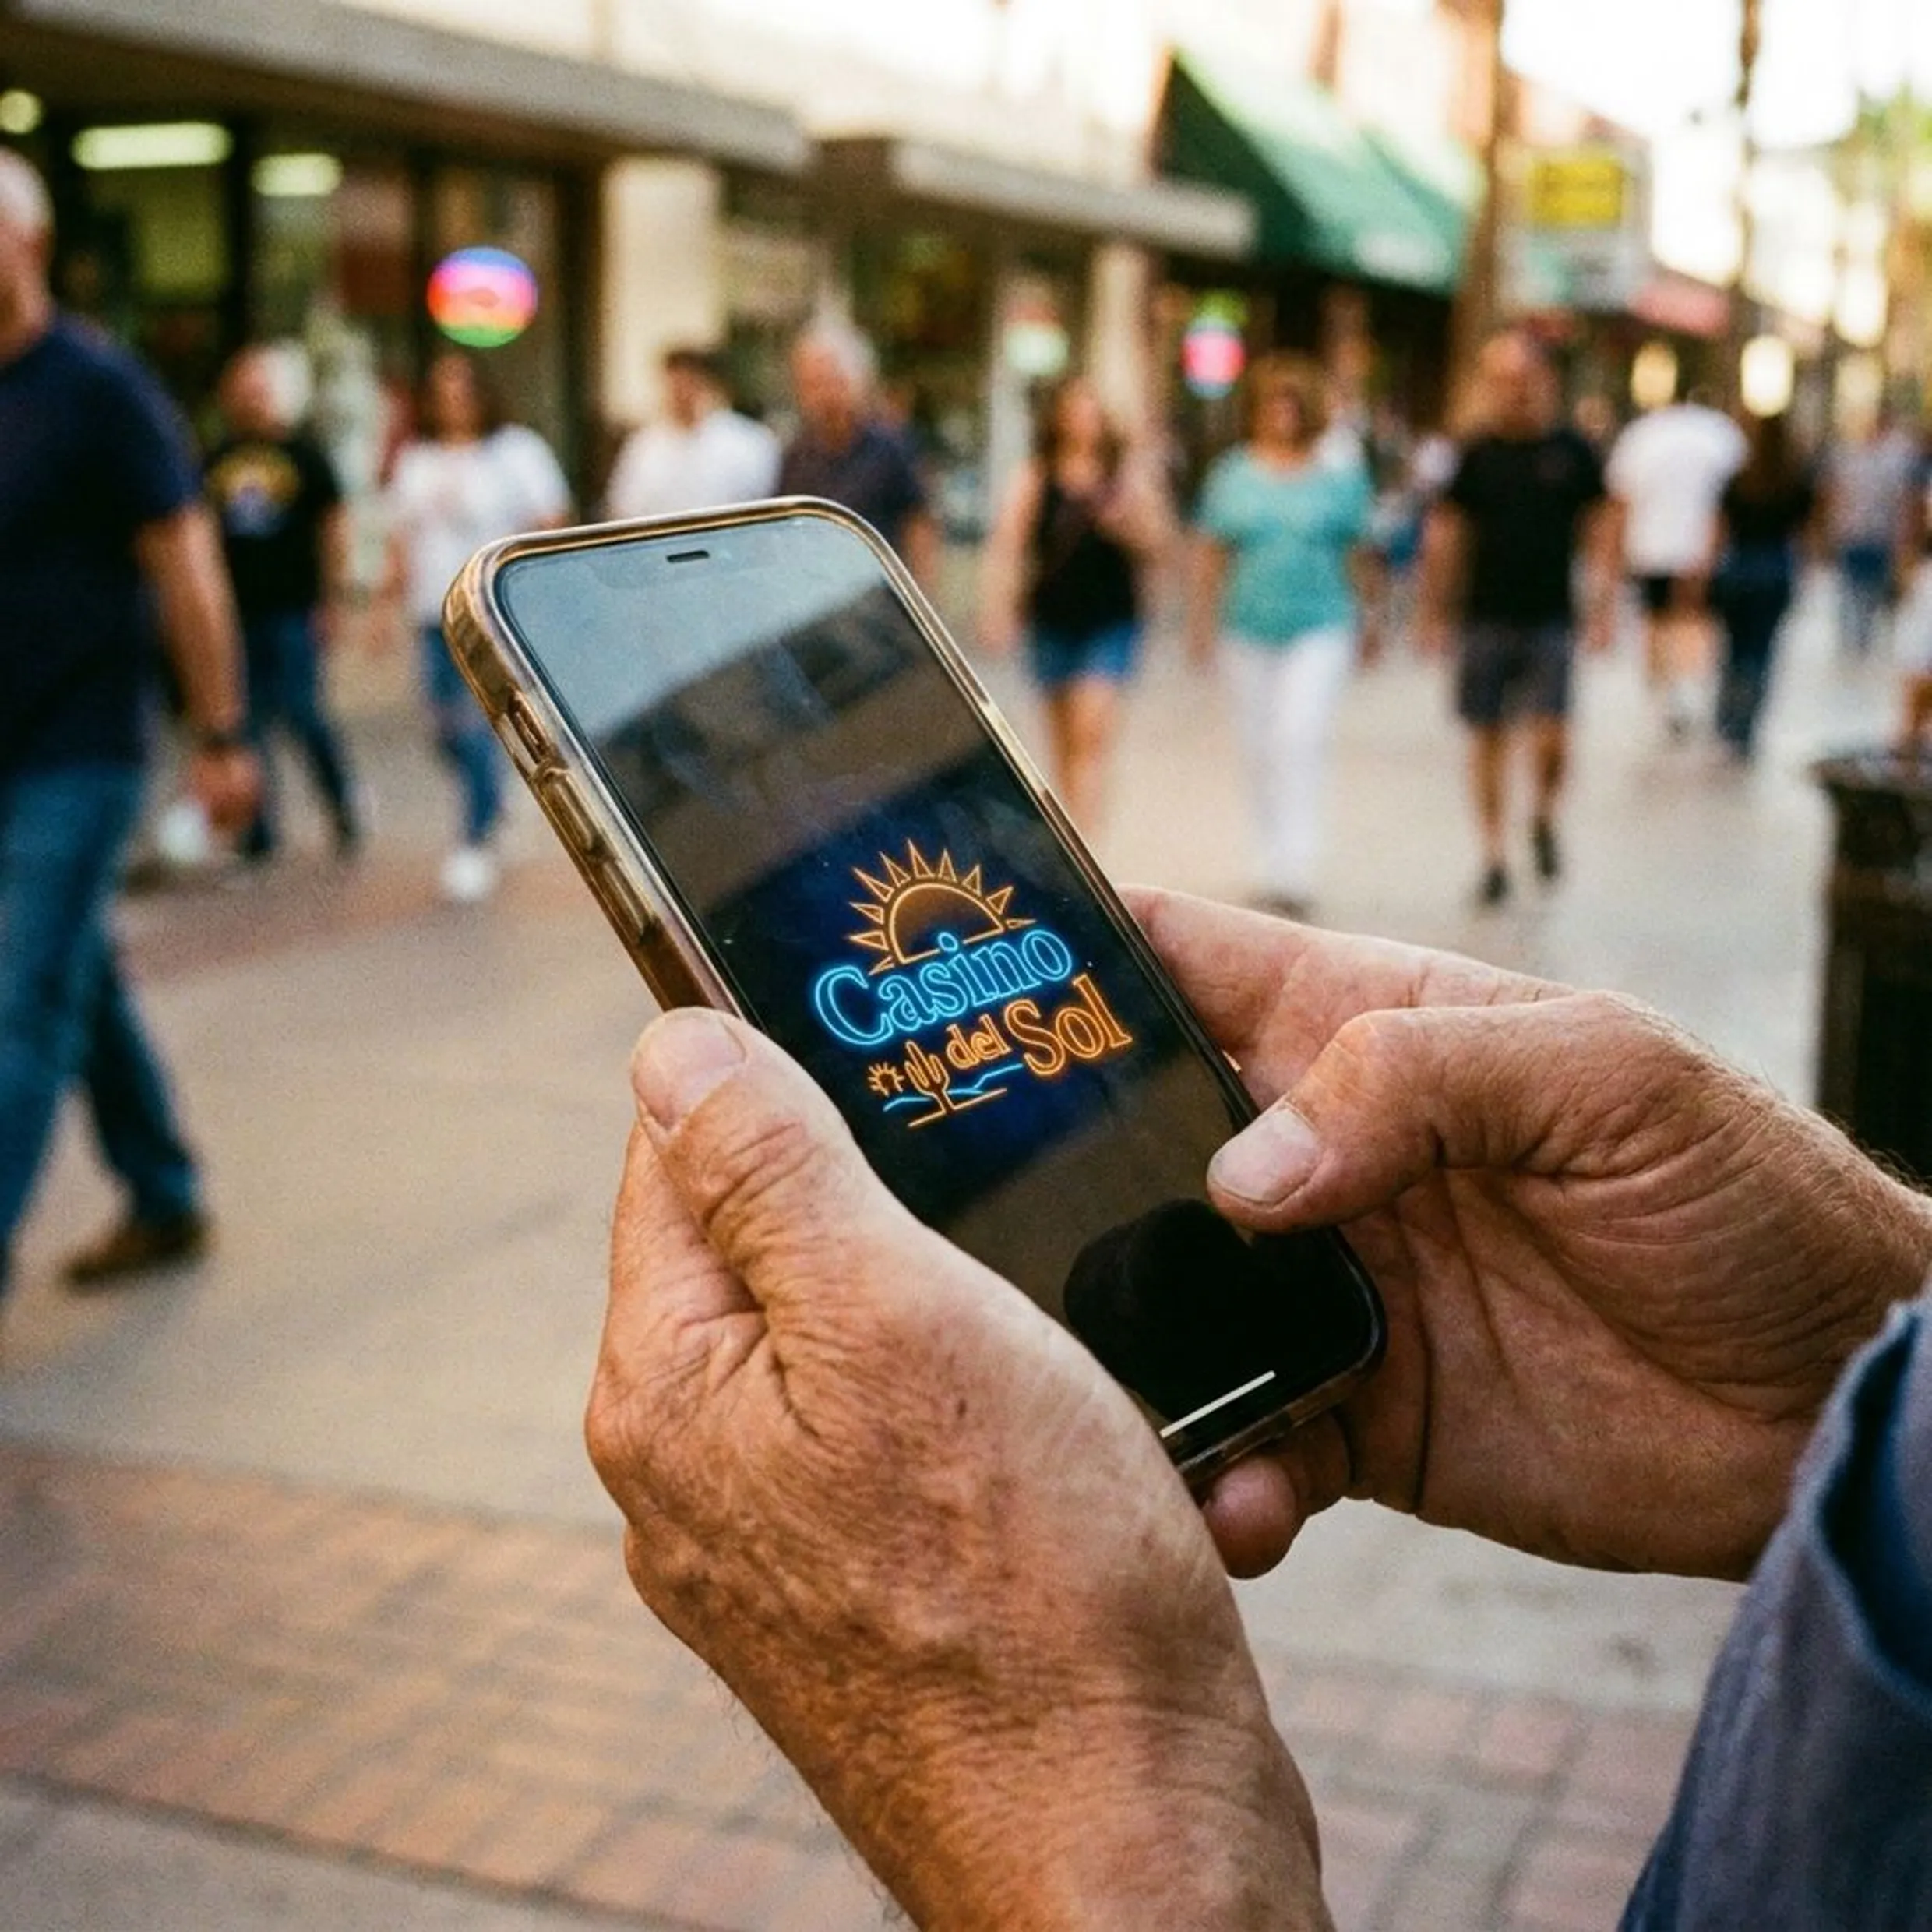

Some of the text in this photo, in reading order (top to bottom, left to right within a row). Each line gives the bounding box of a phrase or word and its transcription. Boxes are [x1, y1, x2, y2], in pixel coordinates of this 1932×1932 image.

[815, 929, 1072, 1045] Casino
[946, 974, 1133, 1076] del Sol
